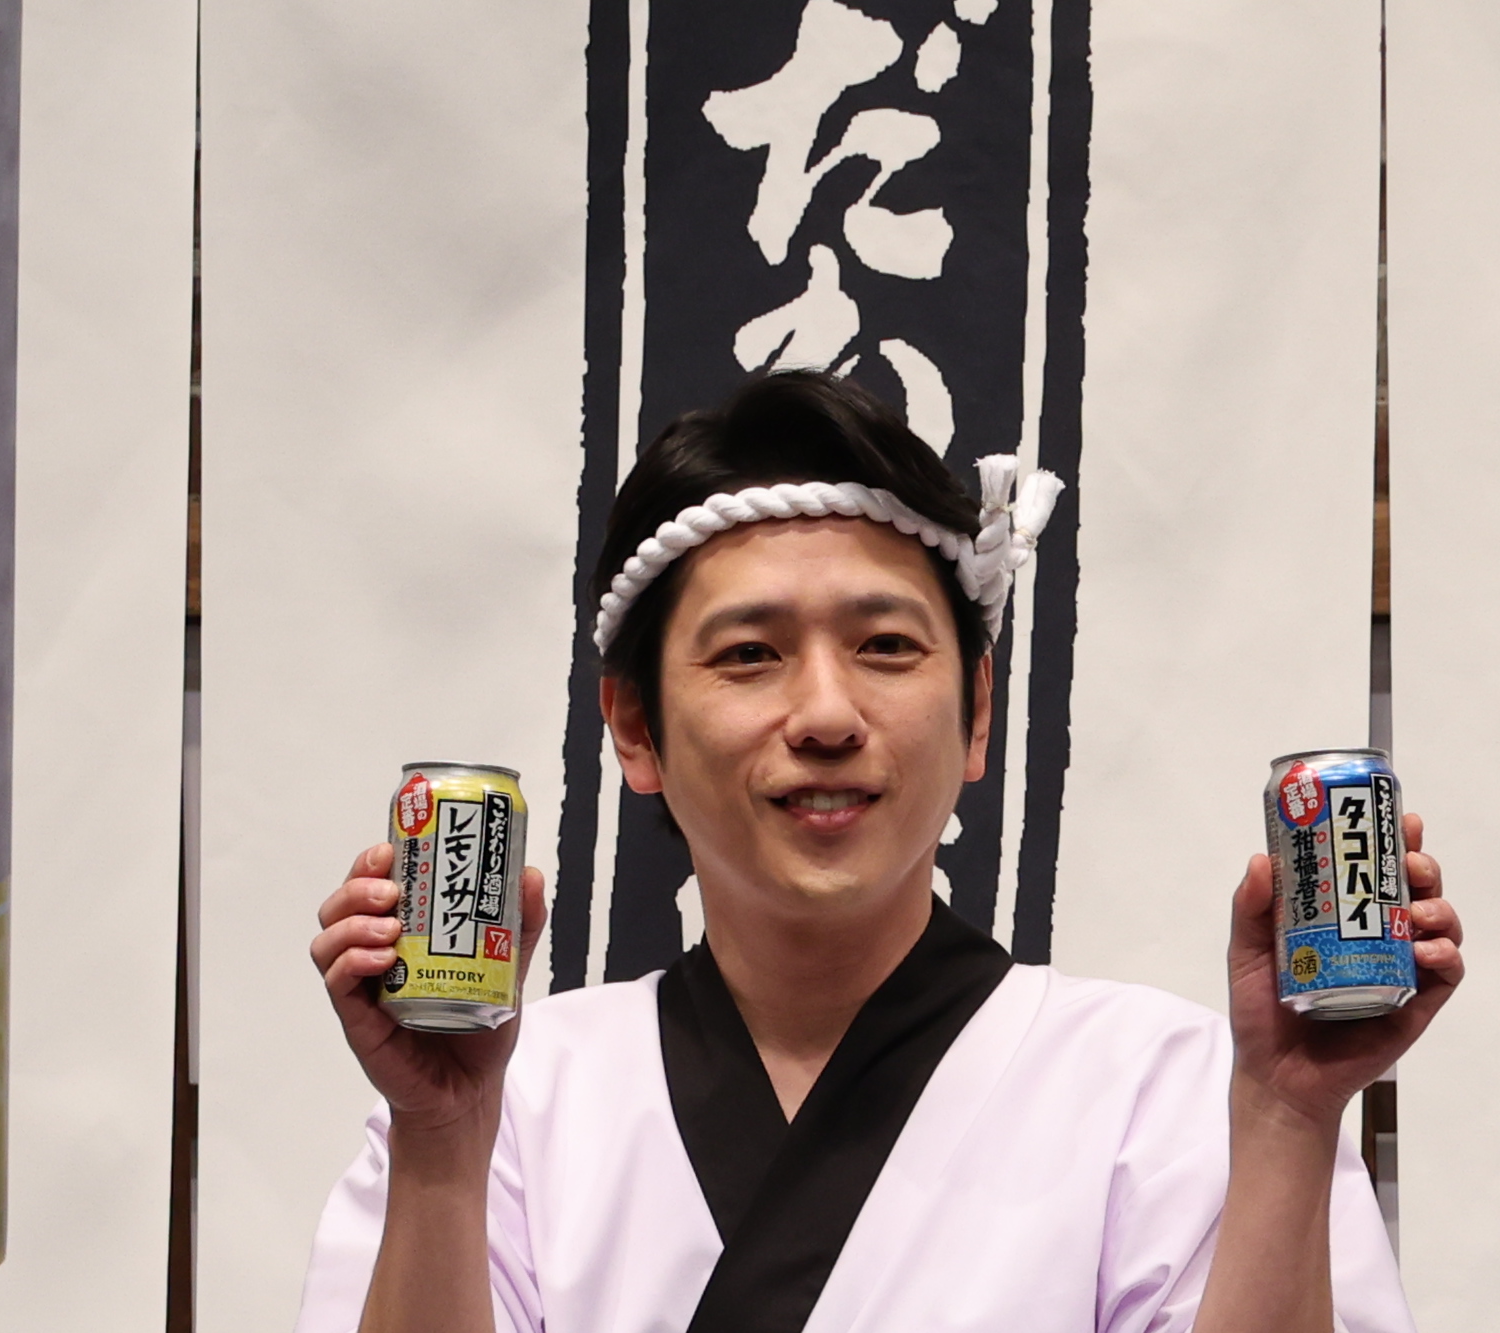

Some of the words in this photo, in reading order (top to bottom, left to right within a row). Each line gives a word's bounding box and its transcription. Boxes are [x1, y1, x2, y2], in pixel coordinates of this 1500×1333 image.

[440, 806, 479, 950] レモンサワー
[478, 797, 508, 918] こだわり酒場
[1291, 826, 1321, 922] 柑橘香る
[1338, 796, 1374, 931] タコハイ
[1377, 779, 1399, 899] こだわり酒場
[416, 968, 485, 984] SUNTORY
